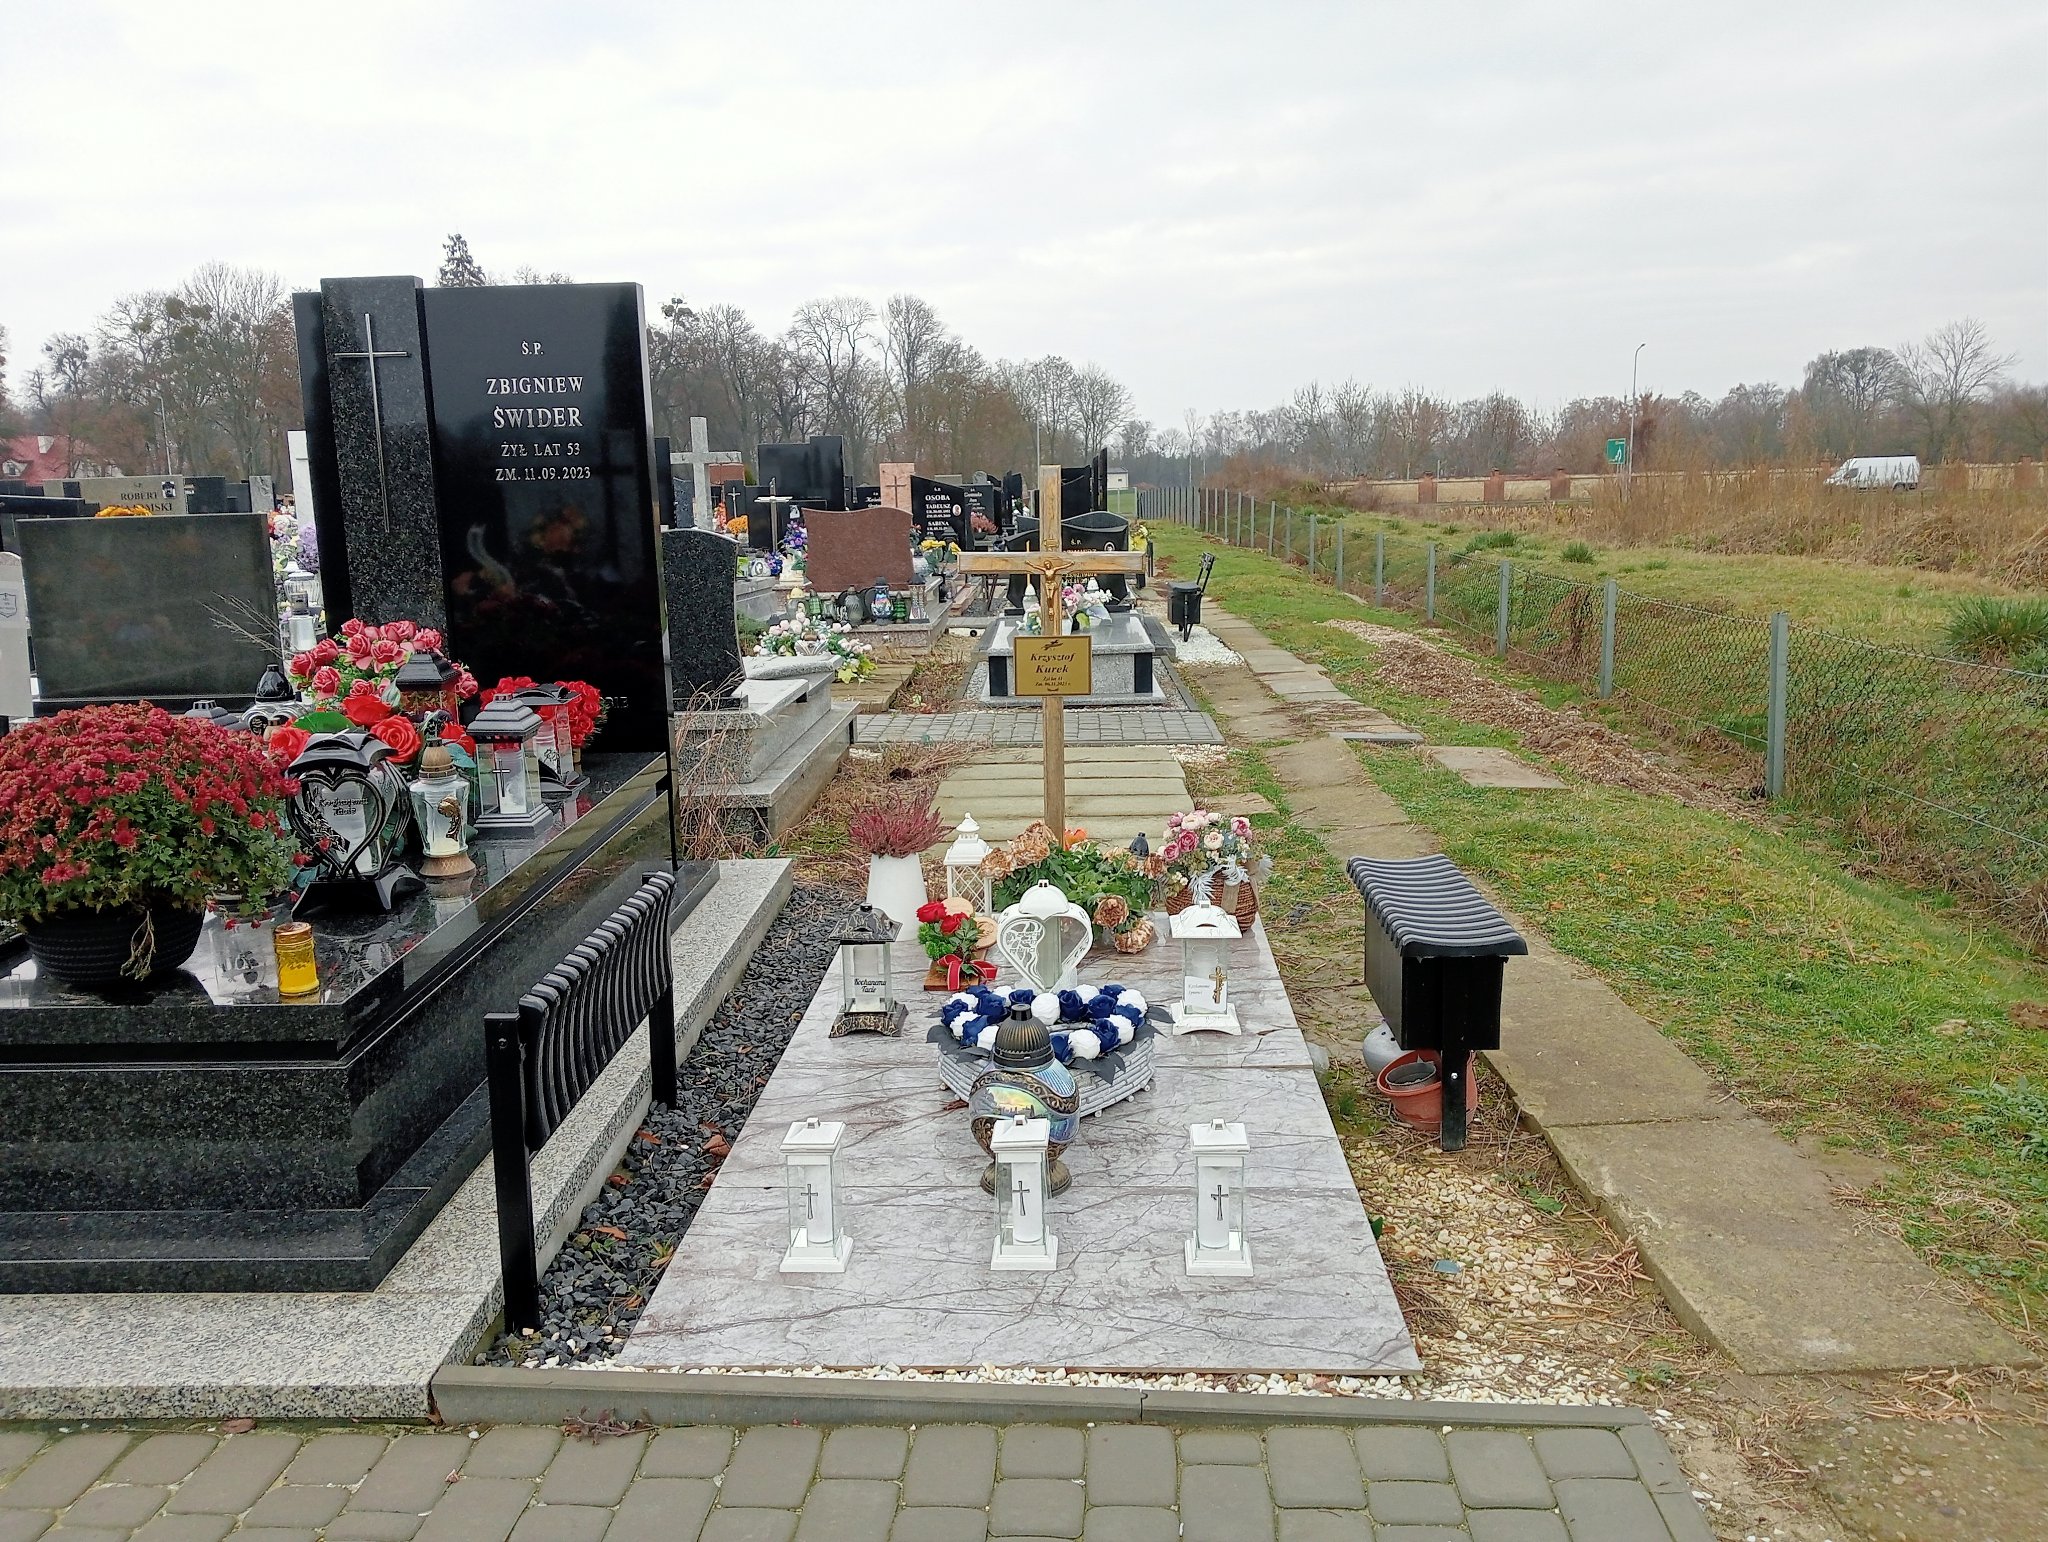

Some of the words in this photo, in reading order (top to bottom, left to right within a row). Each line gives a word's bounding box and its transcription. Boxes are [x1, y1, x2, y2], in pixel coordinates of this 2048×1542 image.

[486, 376, 584, 395] ZBIGNIEW
[493, 405, 584, 429] ŚWIDER
[500, 441, 528, 457] ŻYŁ
[534, 443, 561, 457] LAT
[567, 442, 581, 456] 53
[495, 467, 521, 481] ZM.
[524, 466, 591, 481] 11.09.2023
[120, 491, 157, 501] ROBERT
[1030, 652, 1076, 662] Krzysztof
[1035, 664, 1069, 674] Kurek
